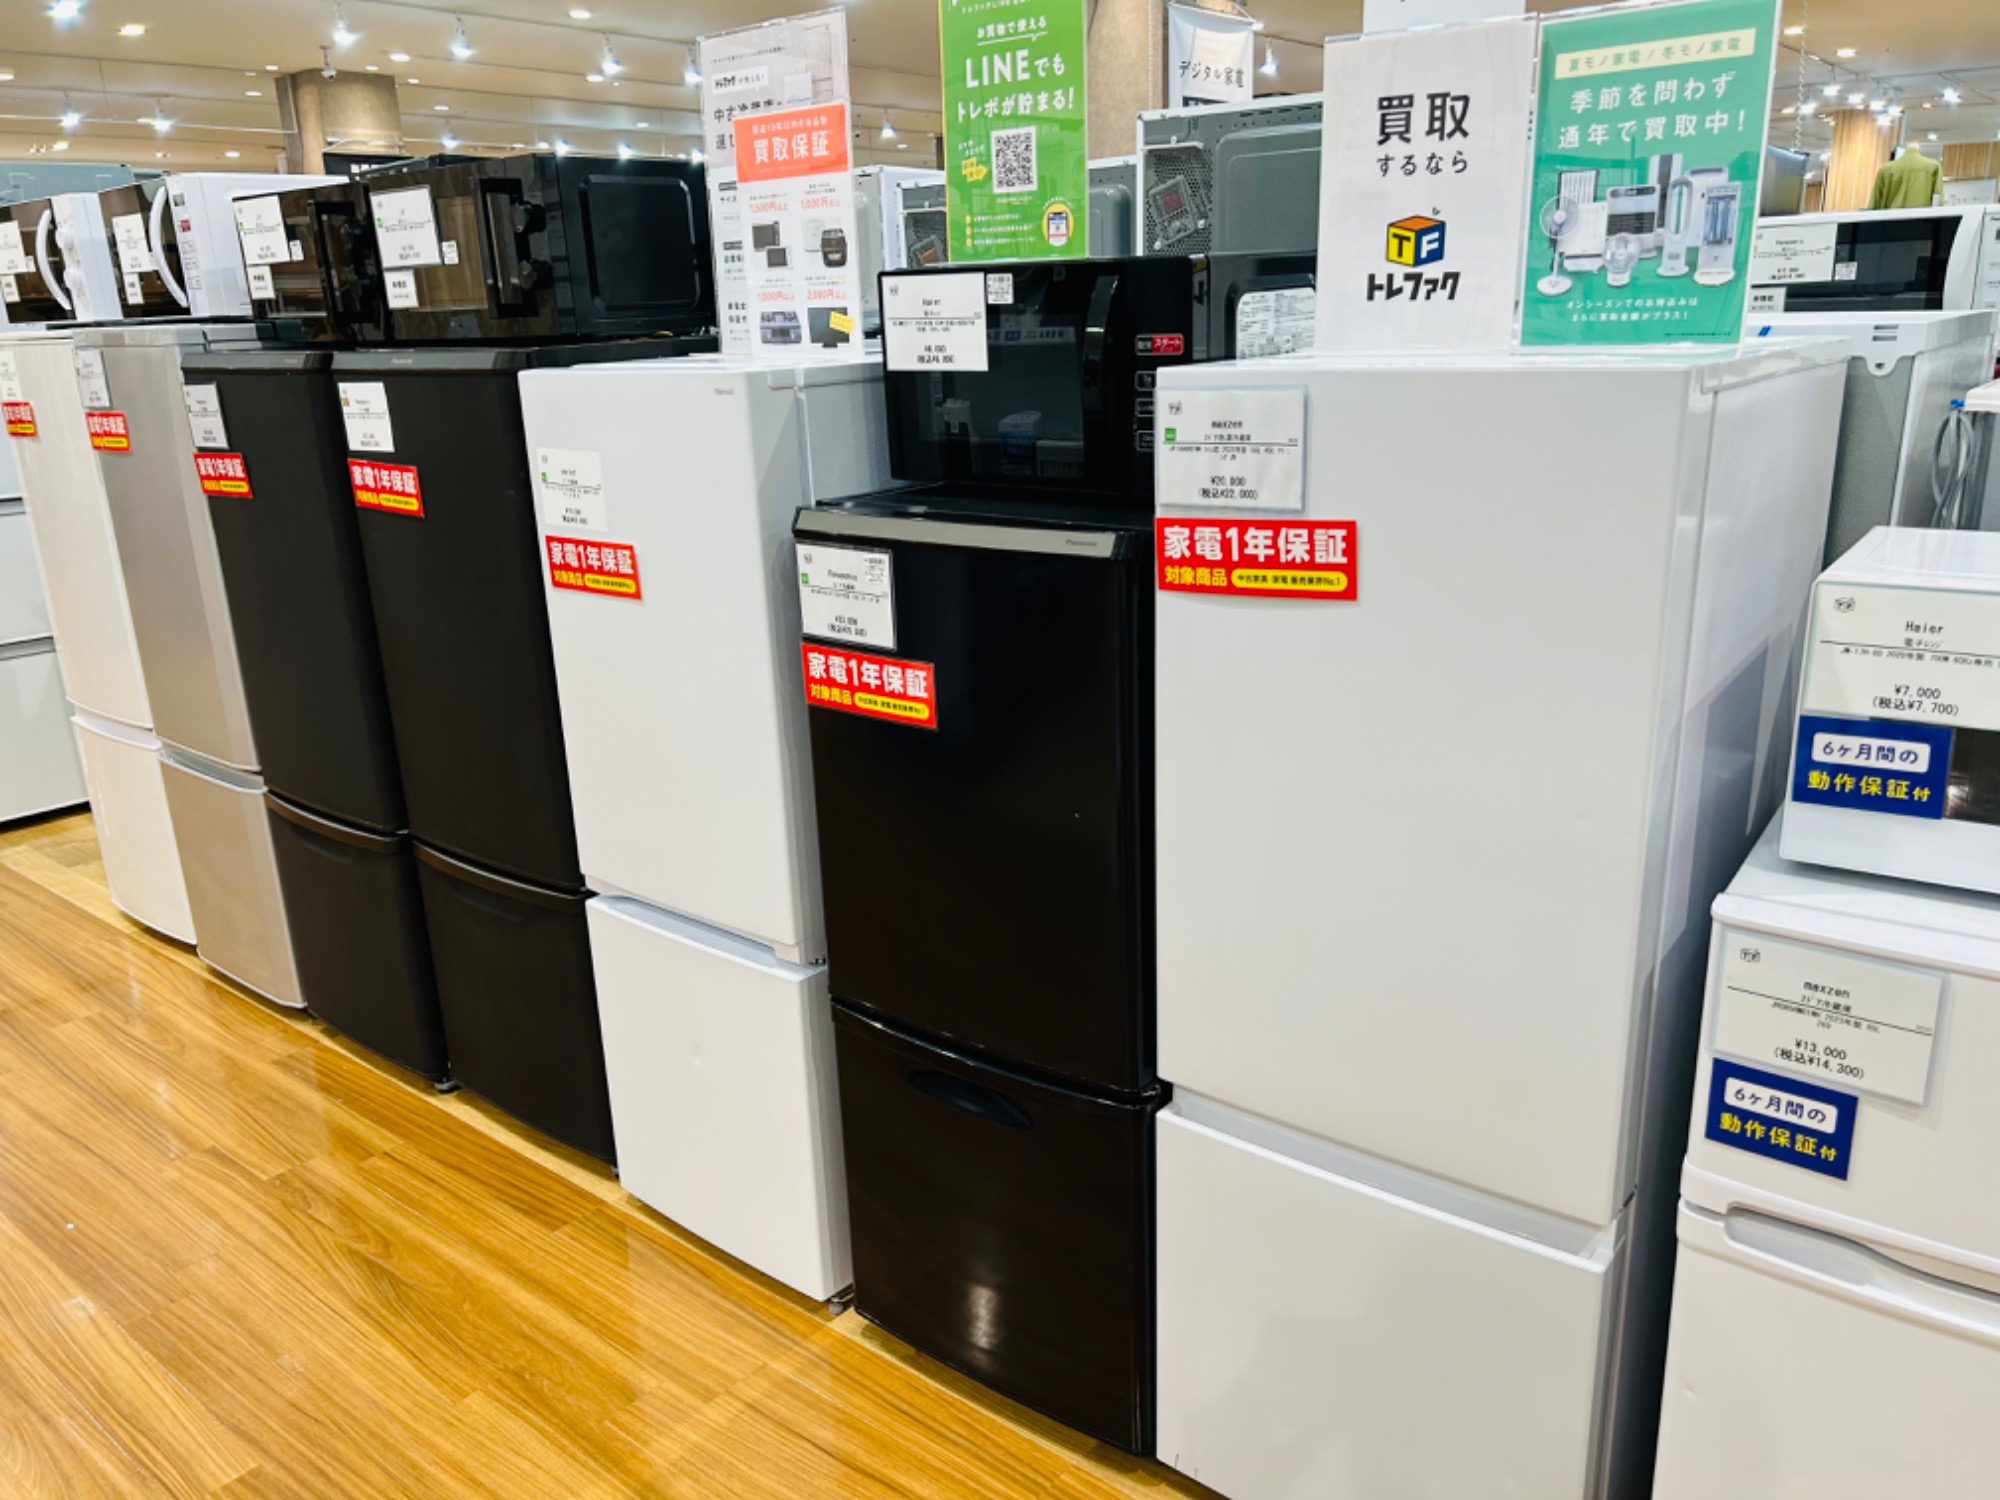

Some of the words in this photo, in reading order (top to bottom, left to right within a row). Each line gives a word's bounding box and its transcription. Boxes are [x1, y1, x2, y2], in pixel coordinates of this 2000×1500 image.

[966, 49, 1065, 88] LINEでも
[1179, 60, 1244, 88] デジタル家電
[1570, 71, 1736, 114] 季節を問わず
[1377, 92, 1470, 146] 買取
[1558, 110, 1746, 149] 通年で買取中!
[753, 130, 830, 165] 買取保証
[1377, 151, 1468, 176] するなら
[1366, 271, 1460, 301] トレファク
[1154, 338, 1181, 348] スタート
[352, 465, 417, 494] 家電1年保証
[550, 542, 634, 574] 家電1年保証
[1163, 525, 1348, 564] 家電1年保証
[1164, 565, 1228, 587] 対象商品
[1905, 621, 1944, 634] Haier
[807, 652, 928, 698] 家電1年保証
[1873, 696, 1959, 716] (税込¥7,700)
[1894, 684, 1941, 699] ¥7,000
[1808, 770, 1930, 802] 動作保証付
[1804, 981, 1850, 998] maxzen
[1774, 1046, 1864, 1080] (税込¥14,300)
[1795, 1038, 1847, 1060] ¥13,000
[1720, 1112, 1837, 1161] 動作保証付
